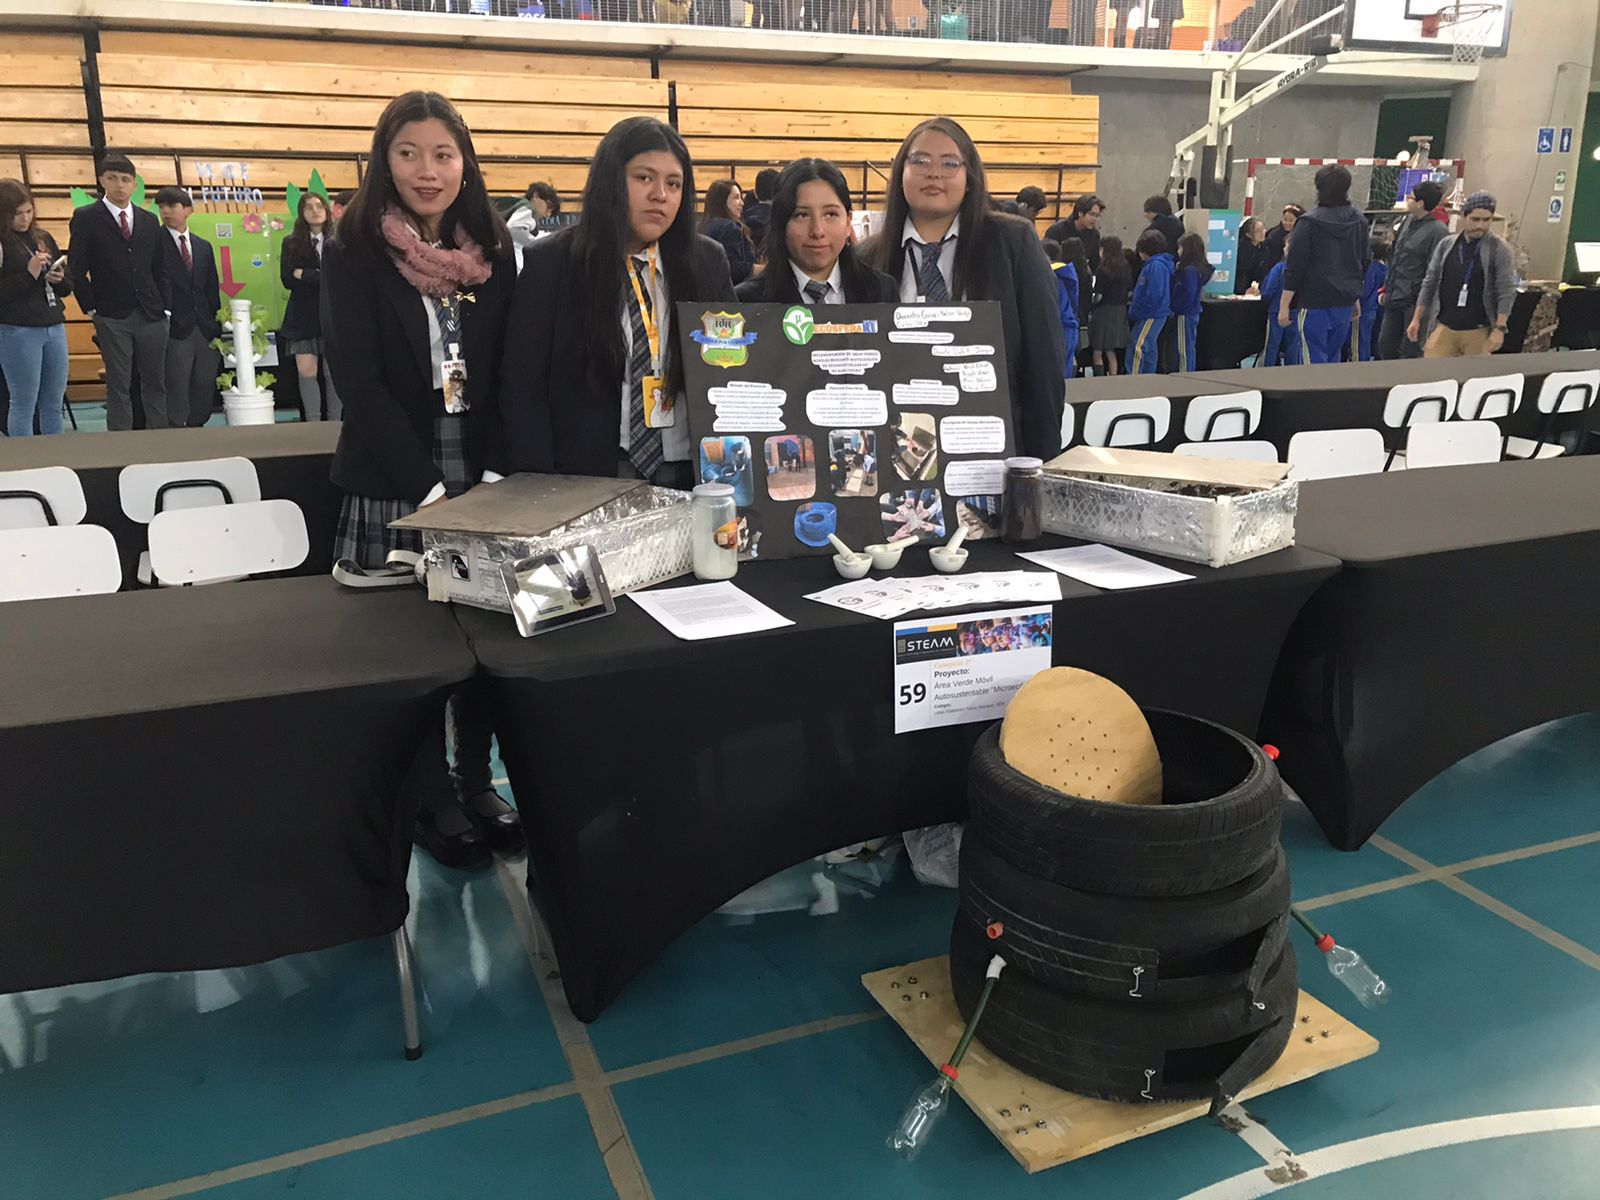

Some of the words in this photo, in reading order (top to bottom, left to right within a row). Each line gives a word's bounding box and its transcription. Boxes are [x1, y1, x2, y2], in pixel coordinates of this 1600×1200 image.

[202, 187, 263, 207] FUTURO
[907, 637, 954, 651] STEAM
[934, 669, 970, 678] Proyecto:
[953, 679, 973, 687] Verde
[899, 683, 927, 706] 59
[934, 688, 989, 700] Autosustentable
